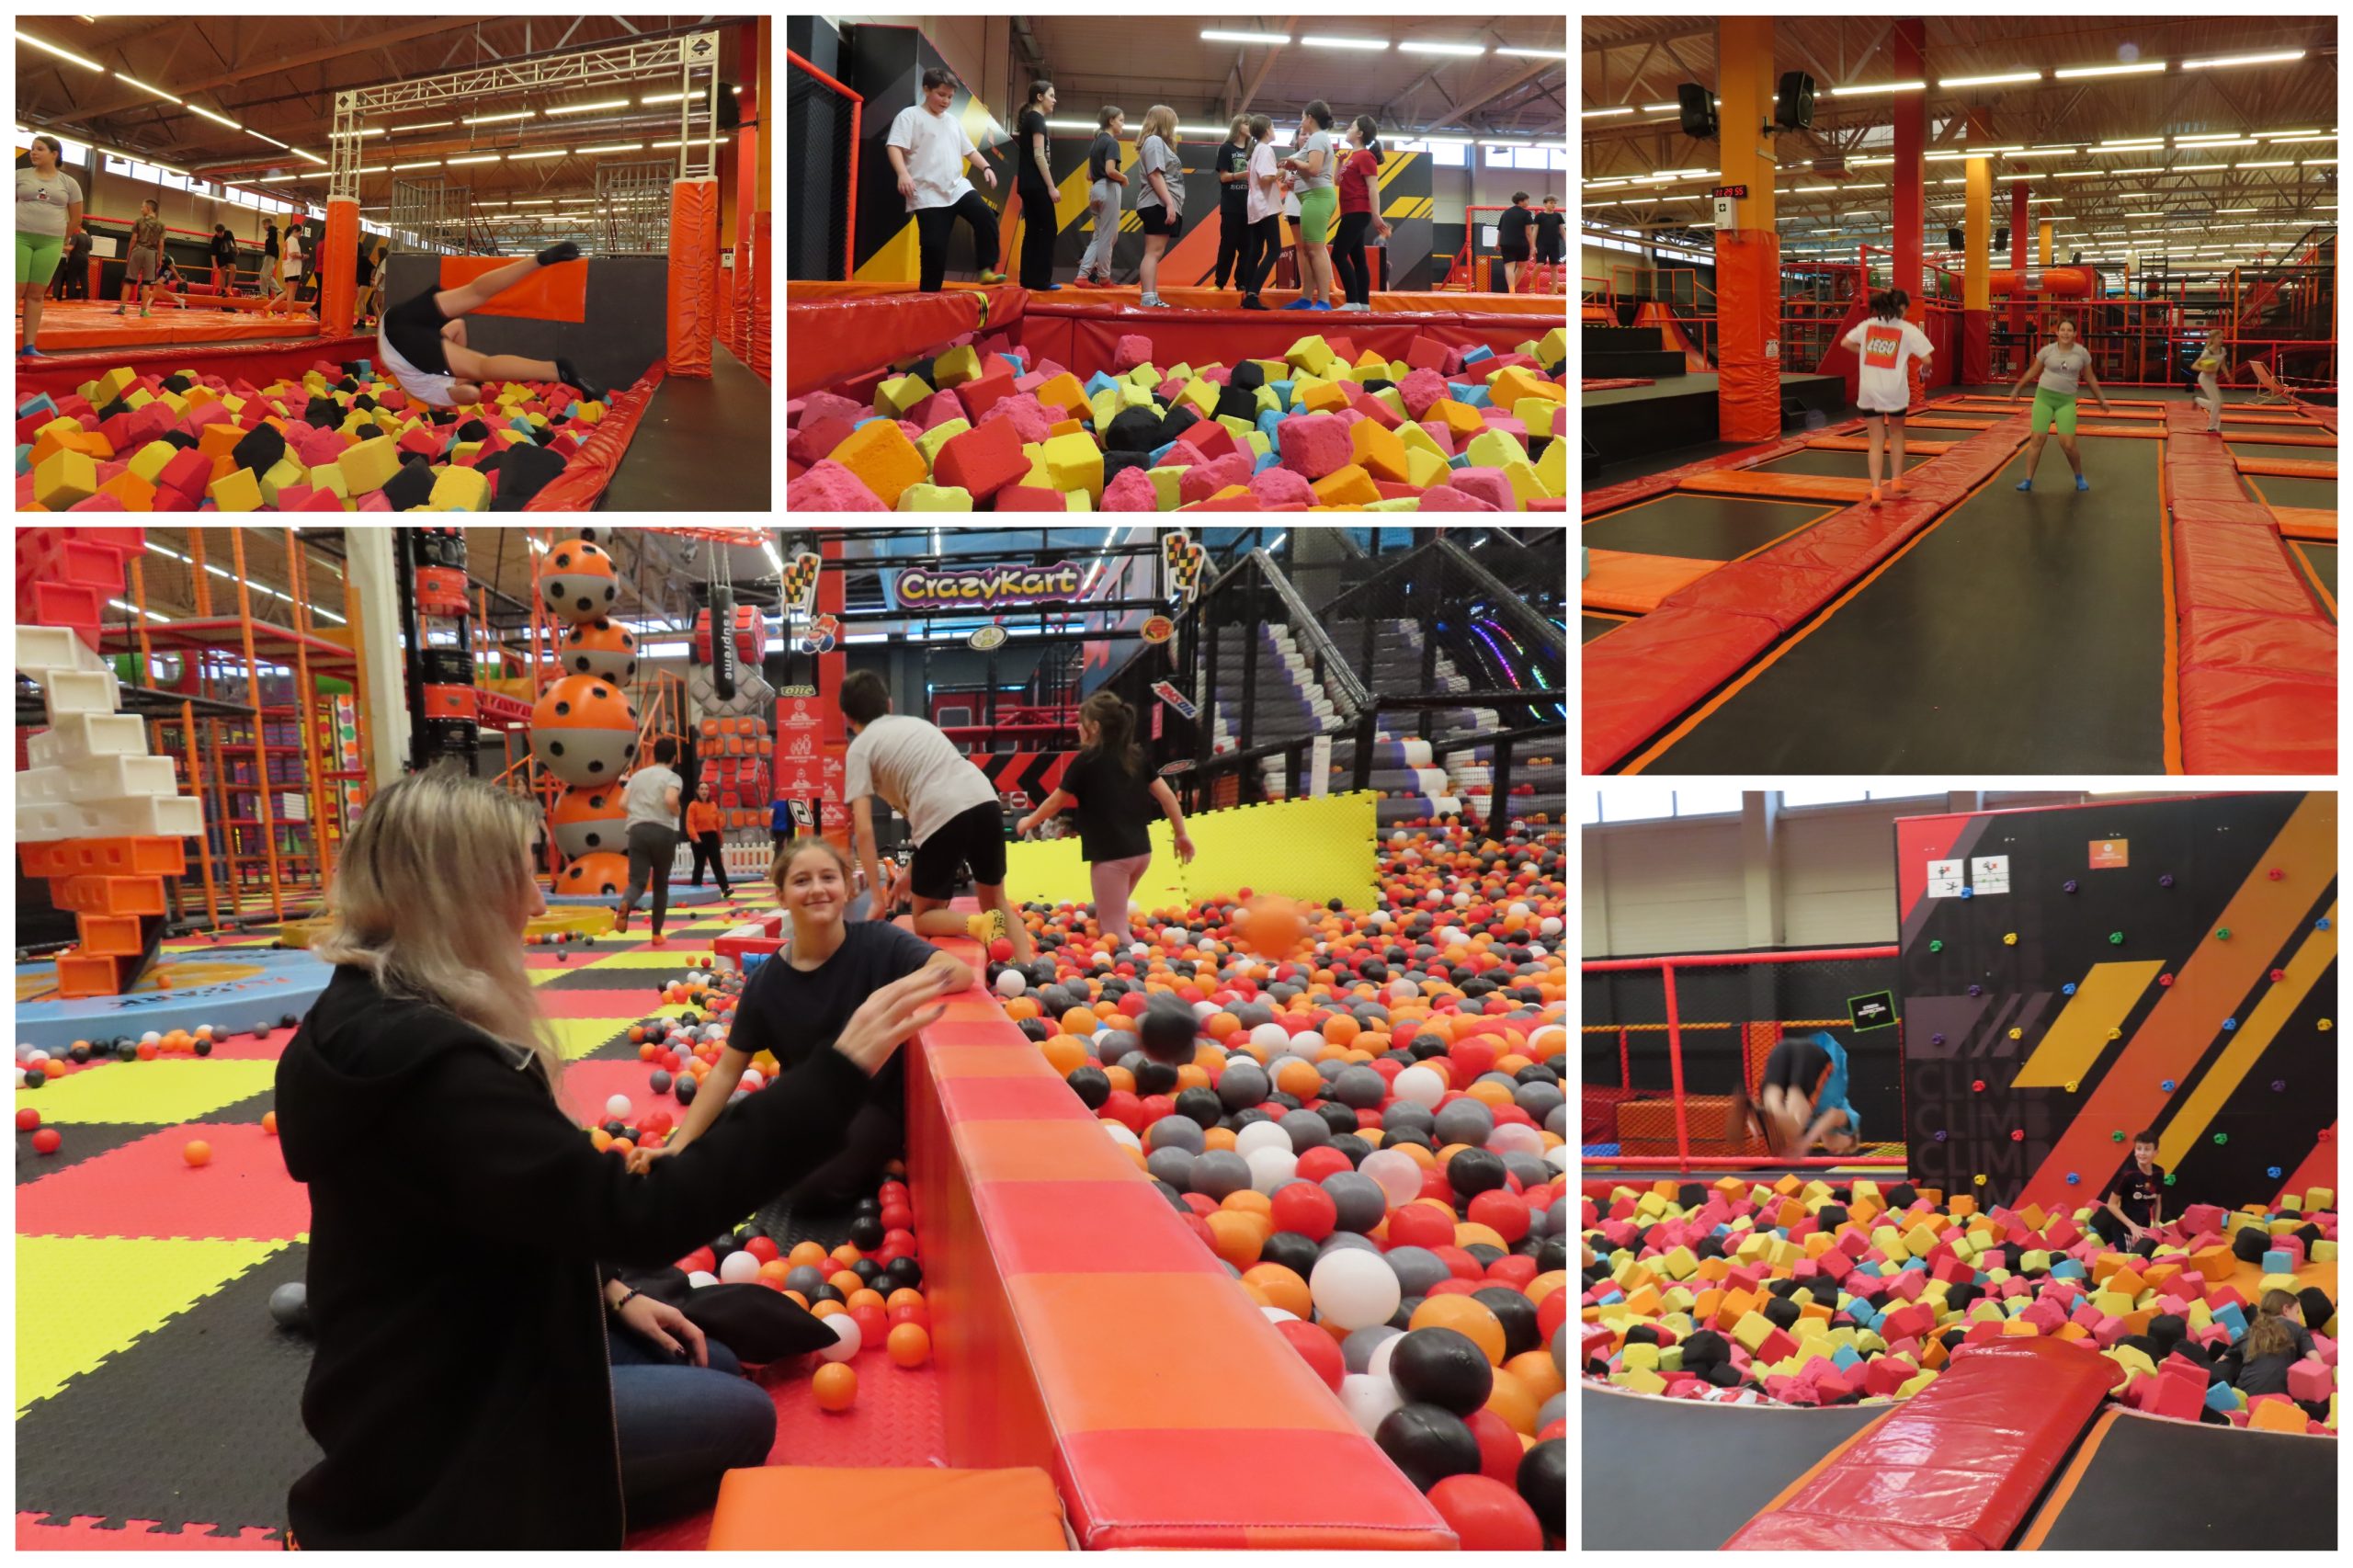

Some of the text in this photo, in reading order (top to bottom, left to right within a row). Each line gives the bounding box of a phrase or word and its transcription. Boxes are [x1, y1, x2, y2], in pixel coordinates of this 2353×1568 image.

[1867, 337, 1897, 355] LEGO
[901, 567, 1078, 599] CrazyKart
[1915, 1102, 2052, 1141] CLIMB
